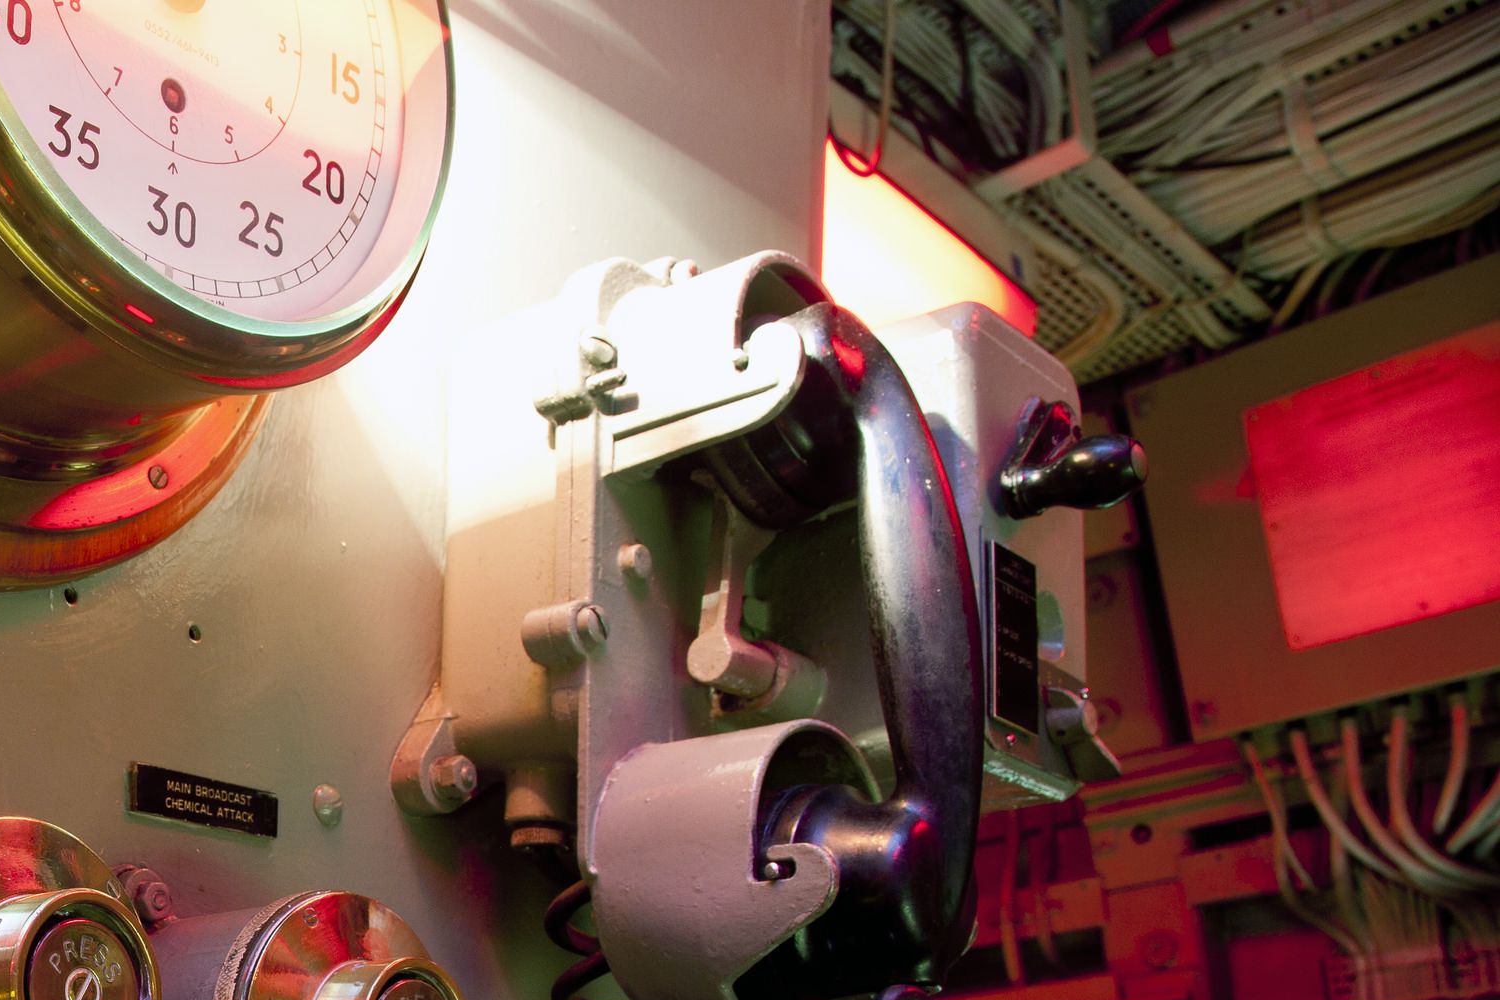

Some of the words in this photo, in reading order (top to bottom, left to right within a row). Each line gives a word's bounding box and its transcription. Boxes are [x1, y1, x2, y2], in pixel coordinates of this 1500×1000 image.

[278, 33, 287, 53] 3
[113, 66, 123, 86] 7
[332, 53, 360, 104] 15
[265, 96, 273, 114] 4
[48, 104, 100, 170] 35
[169, 115, 179, 135] 6
[224, 125, 233, 144] 5
[302, 149, 345, 204] 20
[147, 185, 196, 248] 30
[238, 200, 284, 257] 25
[167, 780, 191, 795] MAIN
[195, 785, 252, 806] BROADCAST
[165, 797, 213, 816] CHEMICAL
[217, 807, 254, 823] ATTACK
[49, 935, 122, 983] PRESS
